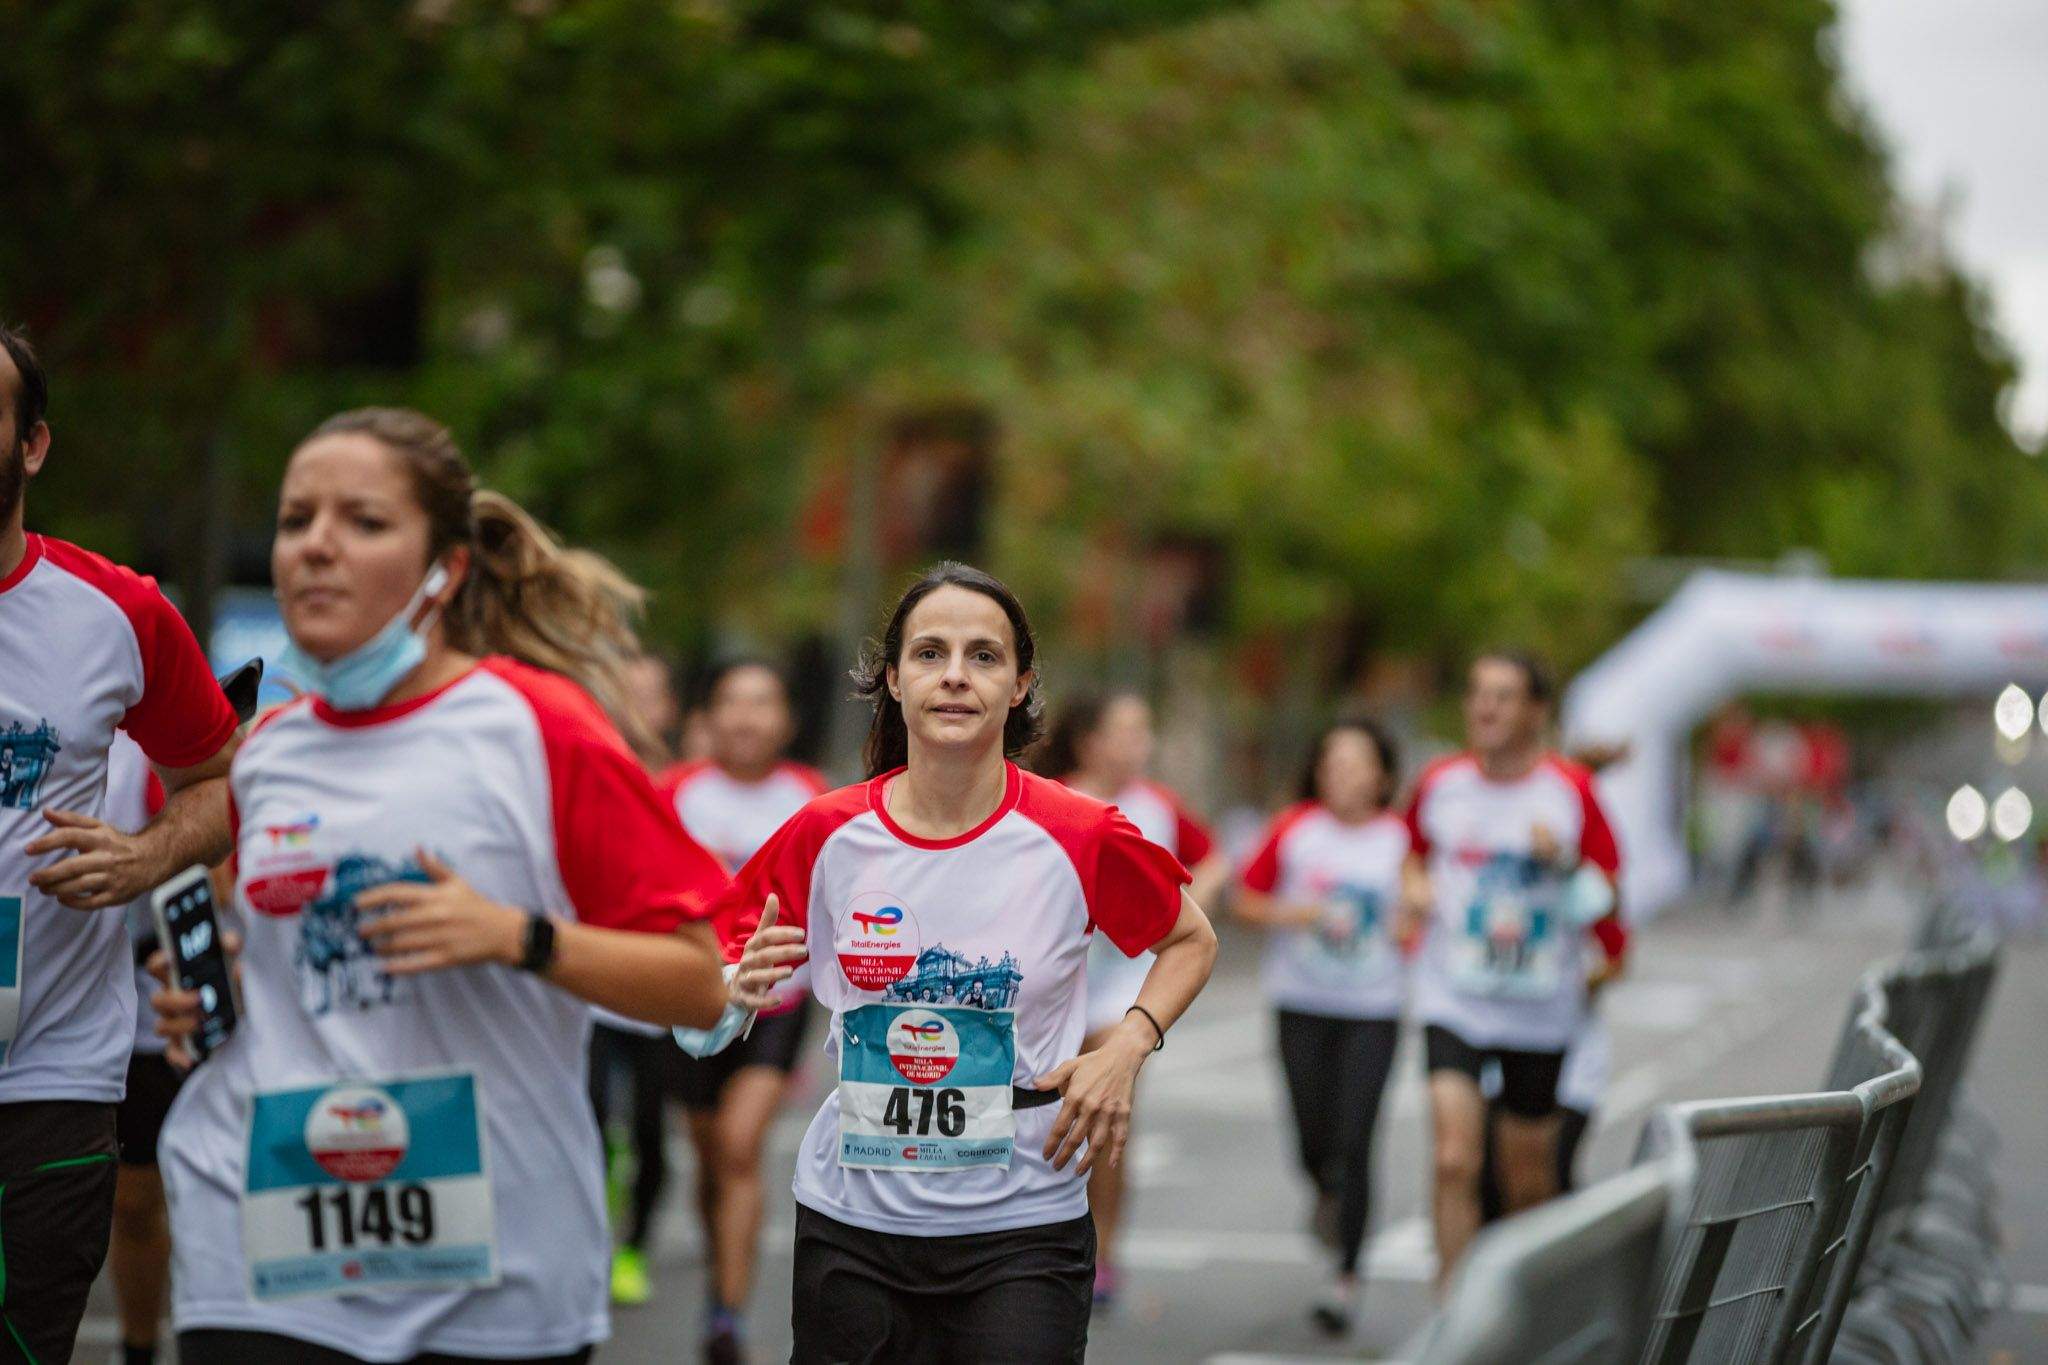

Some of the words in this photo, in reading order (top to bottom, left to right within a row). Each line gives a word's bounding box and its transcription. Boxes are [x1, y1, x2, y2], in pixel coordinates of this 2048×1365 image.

[851, 941, 901, 950] TotalEnergies
[860, 958, 884, 966] MILLA
[916, 1071, 941, 1079] MADRID
[883, 1086, 966, 1137] 476
[853, 1146, 892, 1157] MADRID
[297, 1183, 435, 1249] 1149
